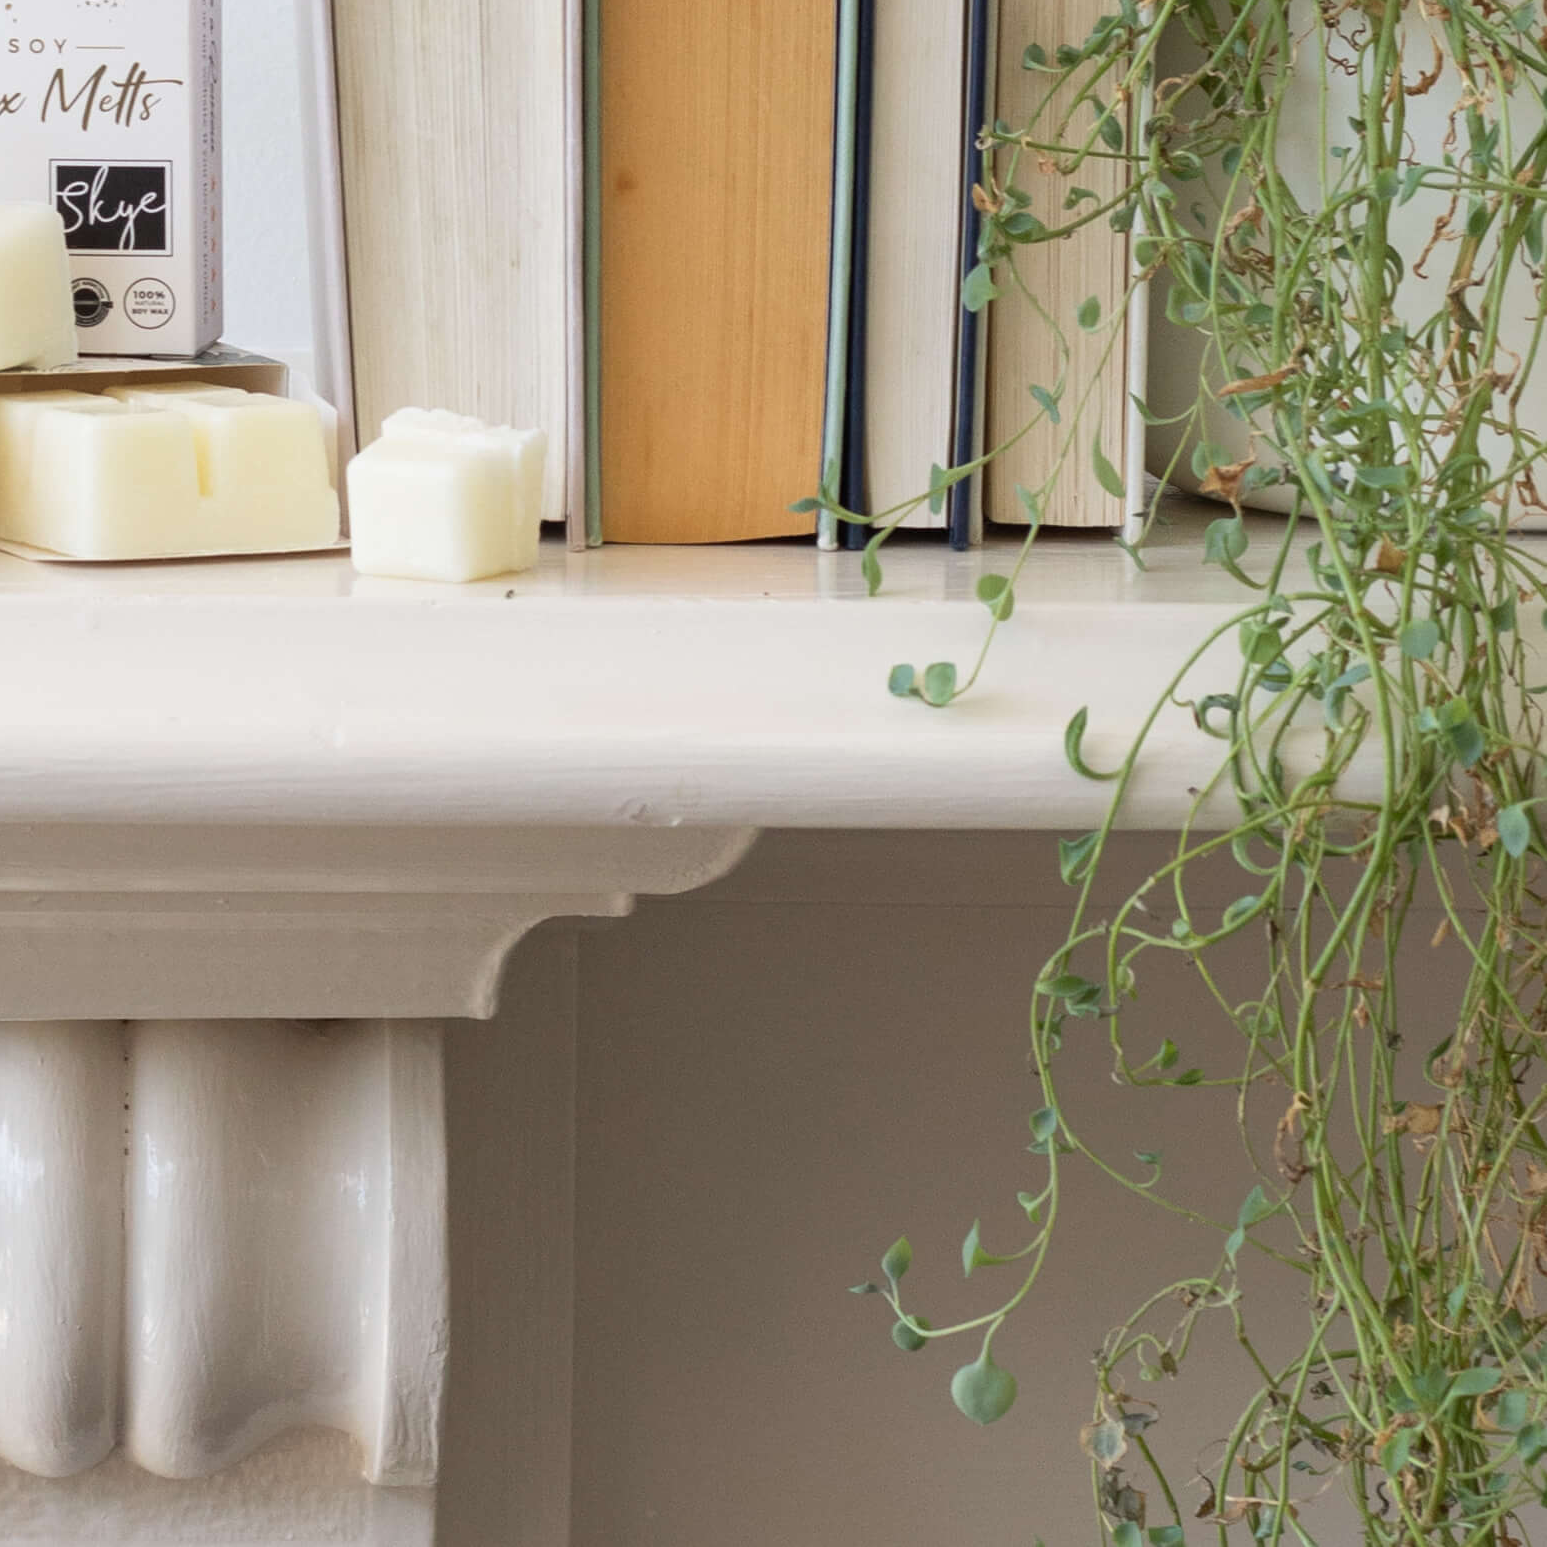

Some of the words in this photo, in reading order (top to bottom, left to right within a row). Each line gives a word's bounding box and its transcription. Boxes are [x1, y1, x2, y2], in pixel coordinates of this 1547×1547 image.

[8, 37, 67, 54] SOY
[40, 61, 184, 131] Melts
[55, 164, 167, 251] Skye
[133, 290, 166, 301] 100%
